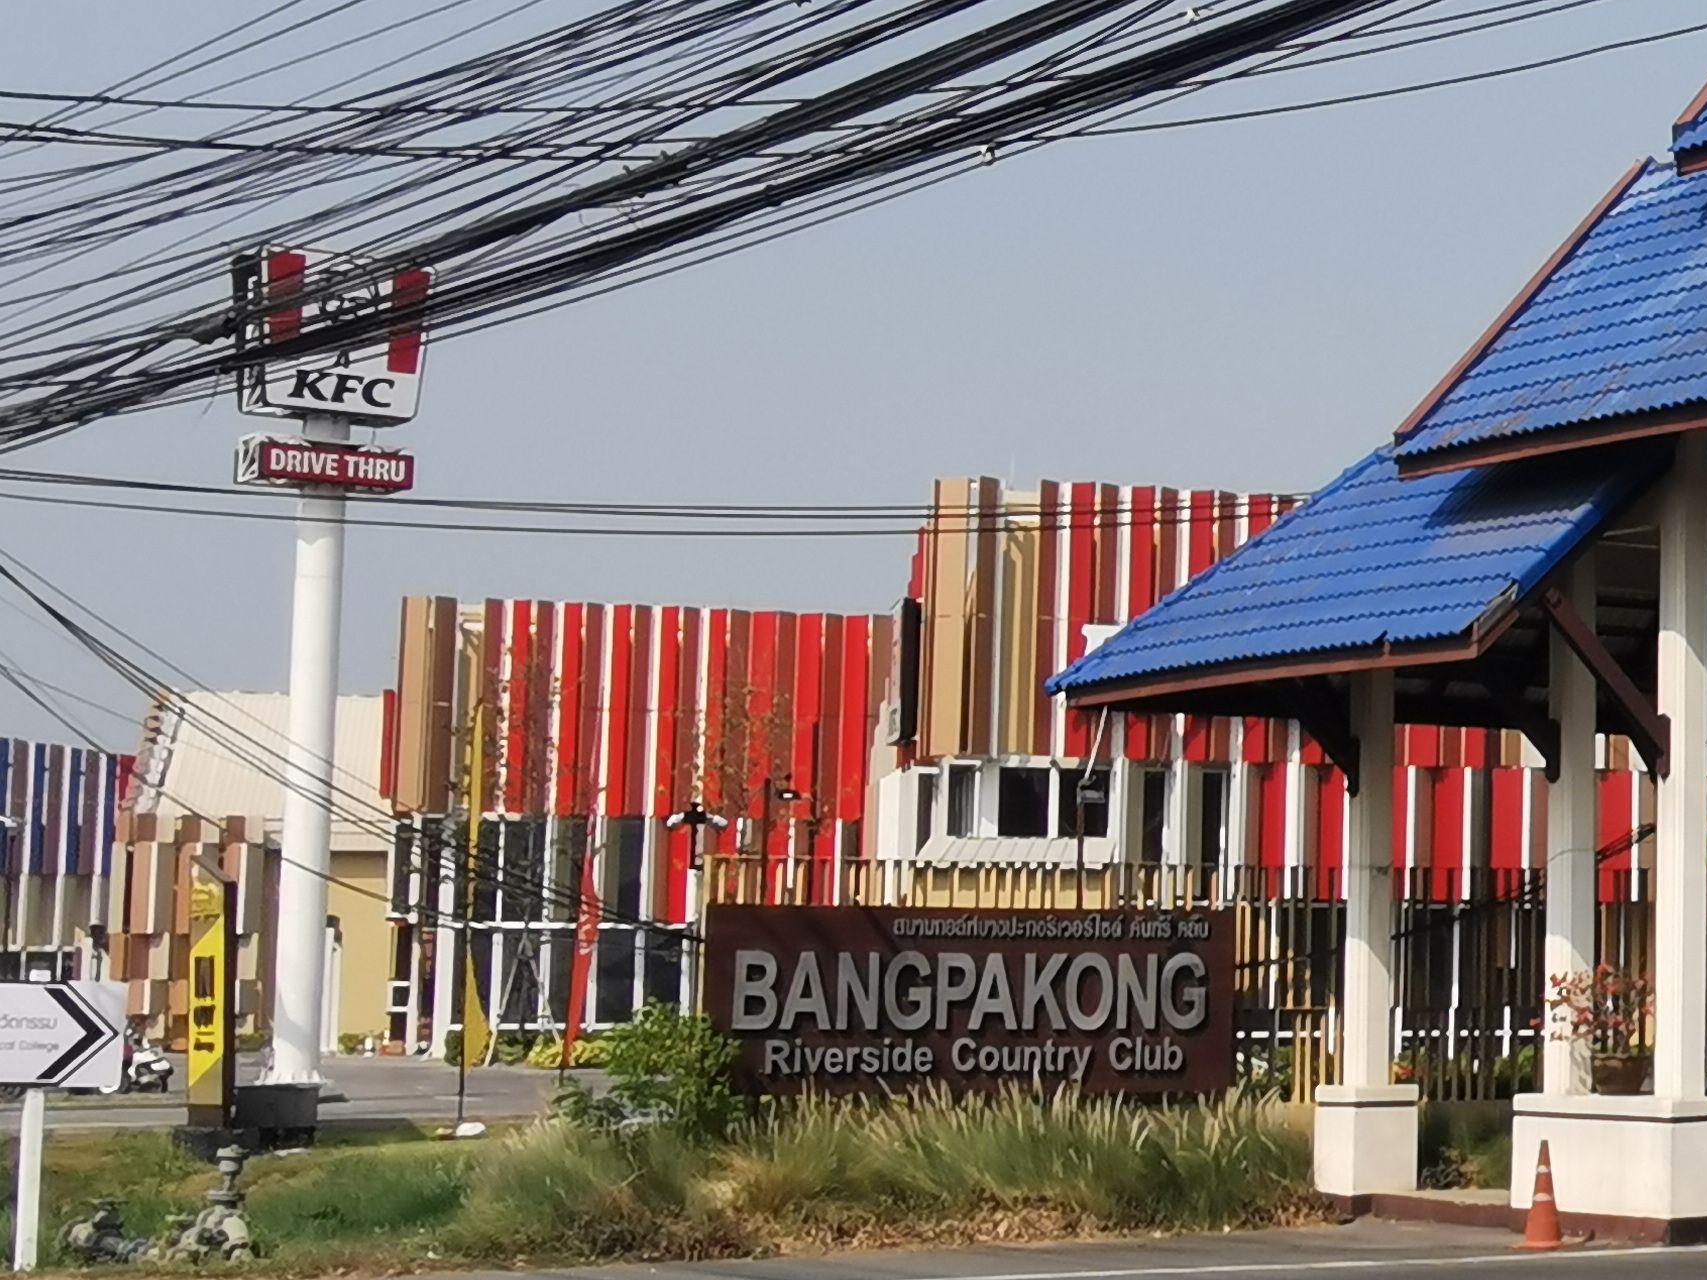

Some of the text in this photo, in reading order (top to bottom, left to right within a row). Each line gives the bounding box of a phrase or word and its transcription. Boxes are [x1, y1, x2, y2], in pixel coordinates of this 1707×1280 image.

[287, 369, 395, 408] KFC
[270, 448, 406, 482] DRIVE THRU
[732, 949, 1207, 1031] BANGPAKONG
[764, 1037, 1184, 1083] Riverside Country Club
